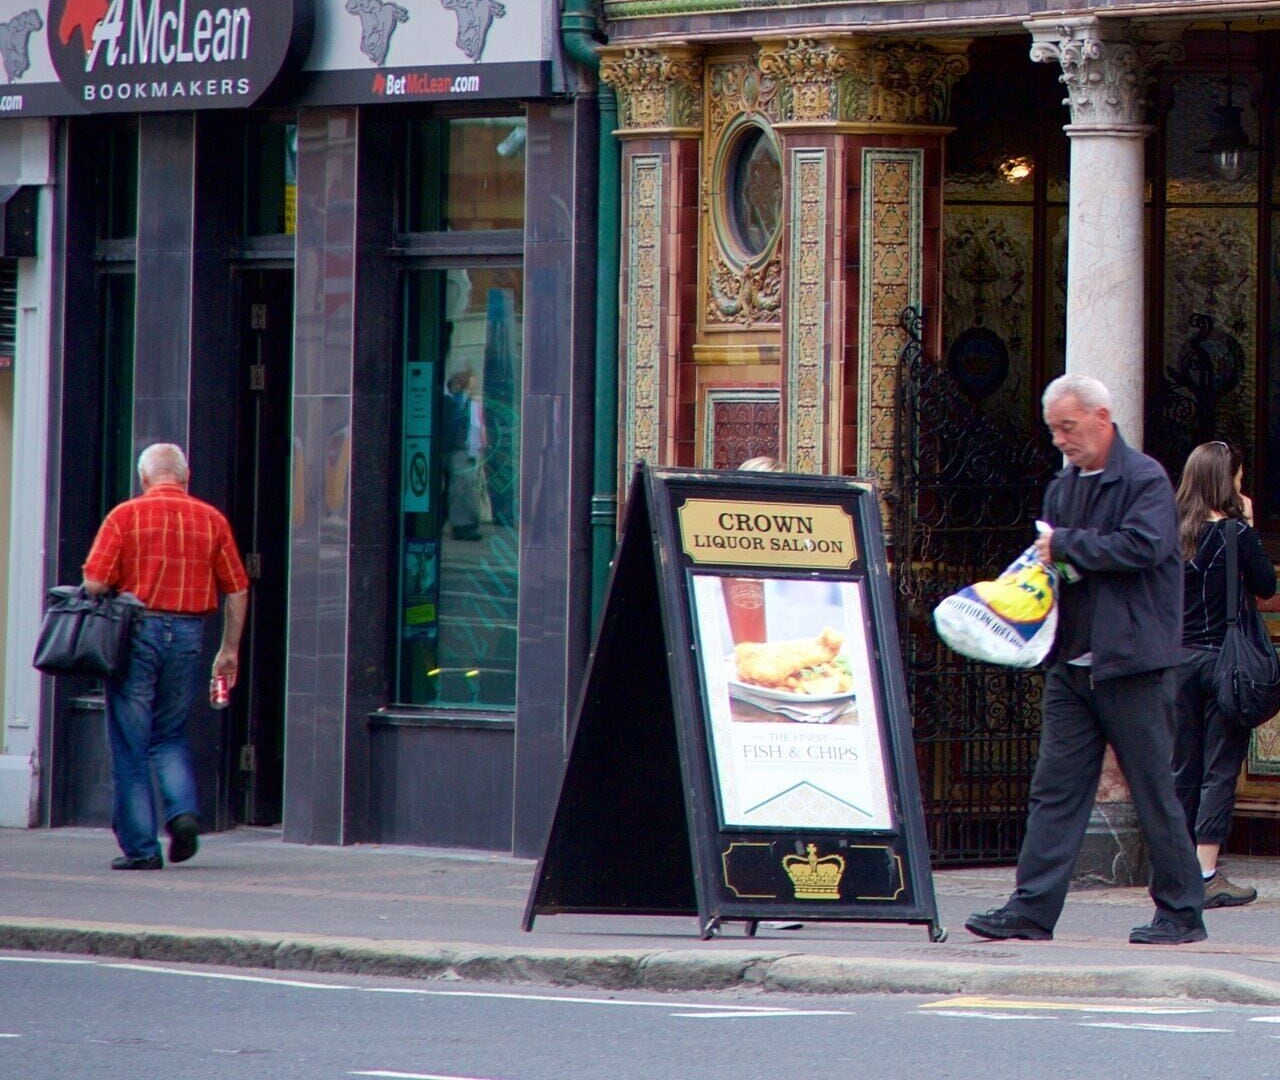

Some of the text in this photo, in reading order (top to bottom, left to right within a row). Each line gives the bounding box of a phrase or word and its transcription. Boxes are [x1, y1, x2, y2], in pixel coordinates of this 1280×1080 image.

[84, 78, 249, 101] BOOKMAKERS
[386, 73, 480, 95] BetMcLean.com
[718, 513, 813, 534] CROWN
[694, 534, 765, 551] LIQUOR
[769, 732, 790, 742] THE
[742, 744, 859, 761] FISH & CHIPS
